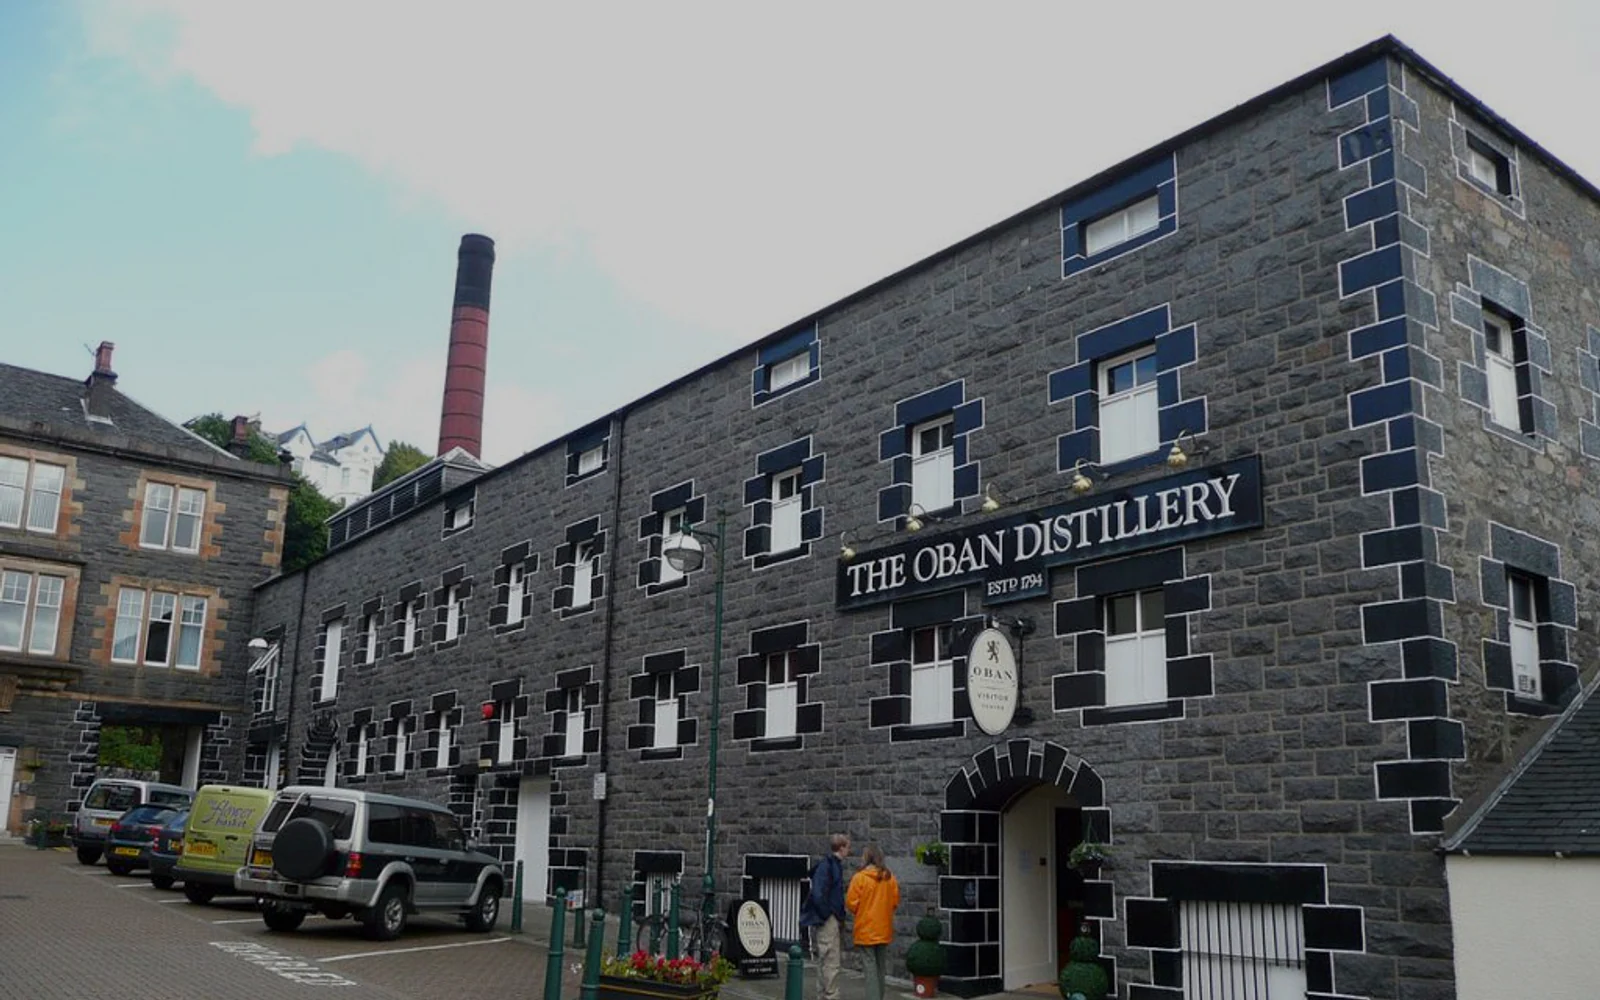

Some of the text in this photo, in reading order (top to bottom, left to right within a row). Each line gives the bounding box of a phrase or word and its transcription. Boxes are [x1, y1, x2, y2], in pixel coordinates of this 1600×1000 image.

[846, 473, 1241, 597] THE OBAN DISTILLERY
[1020, 573, 1043, 590] 1794
[973, 665, 1013, 681] OBAN
[977, 691, 1009, 702] VISITOR
